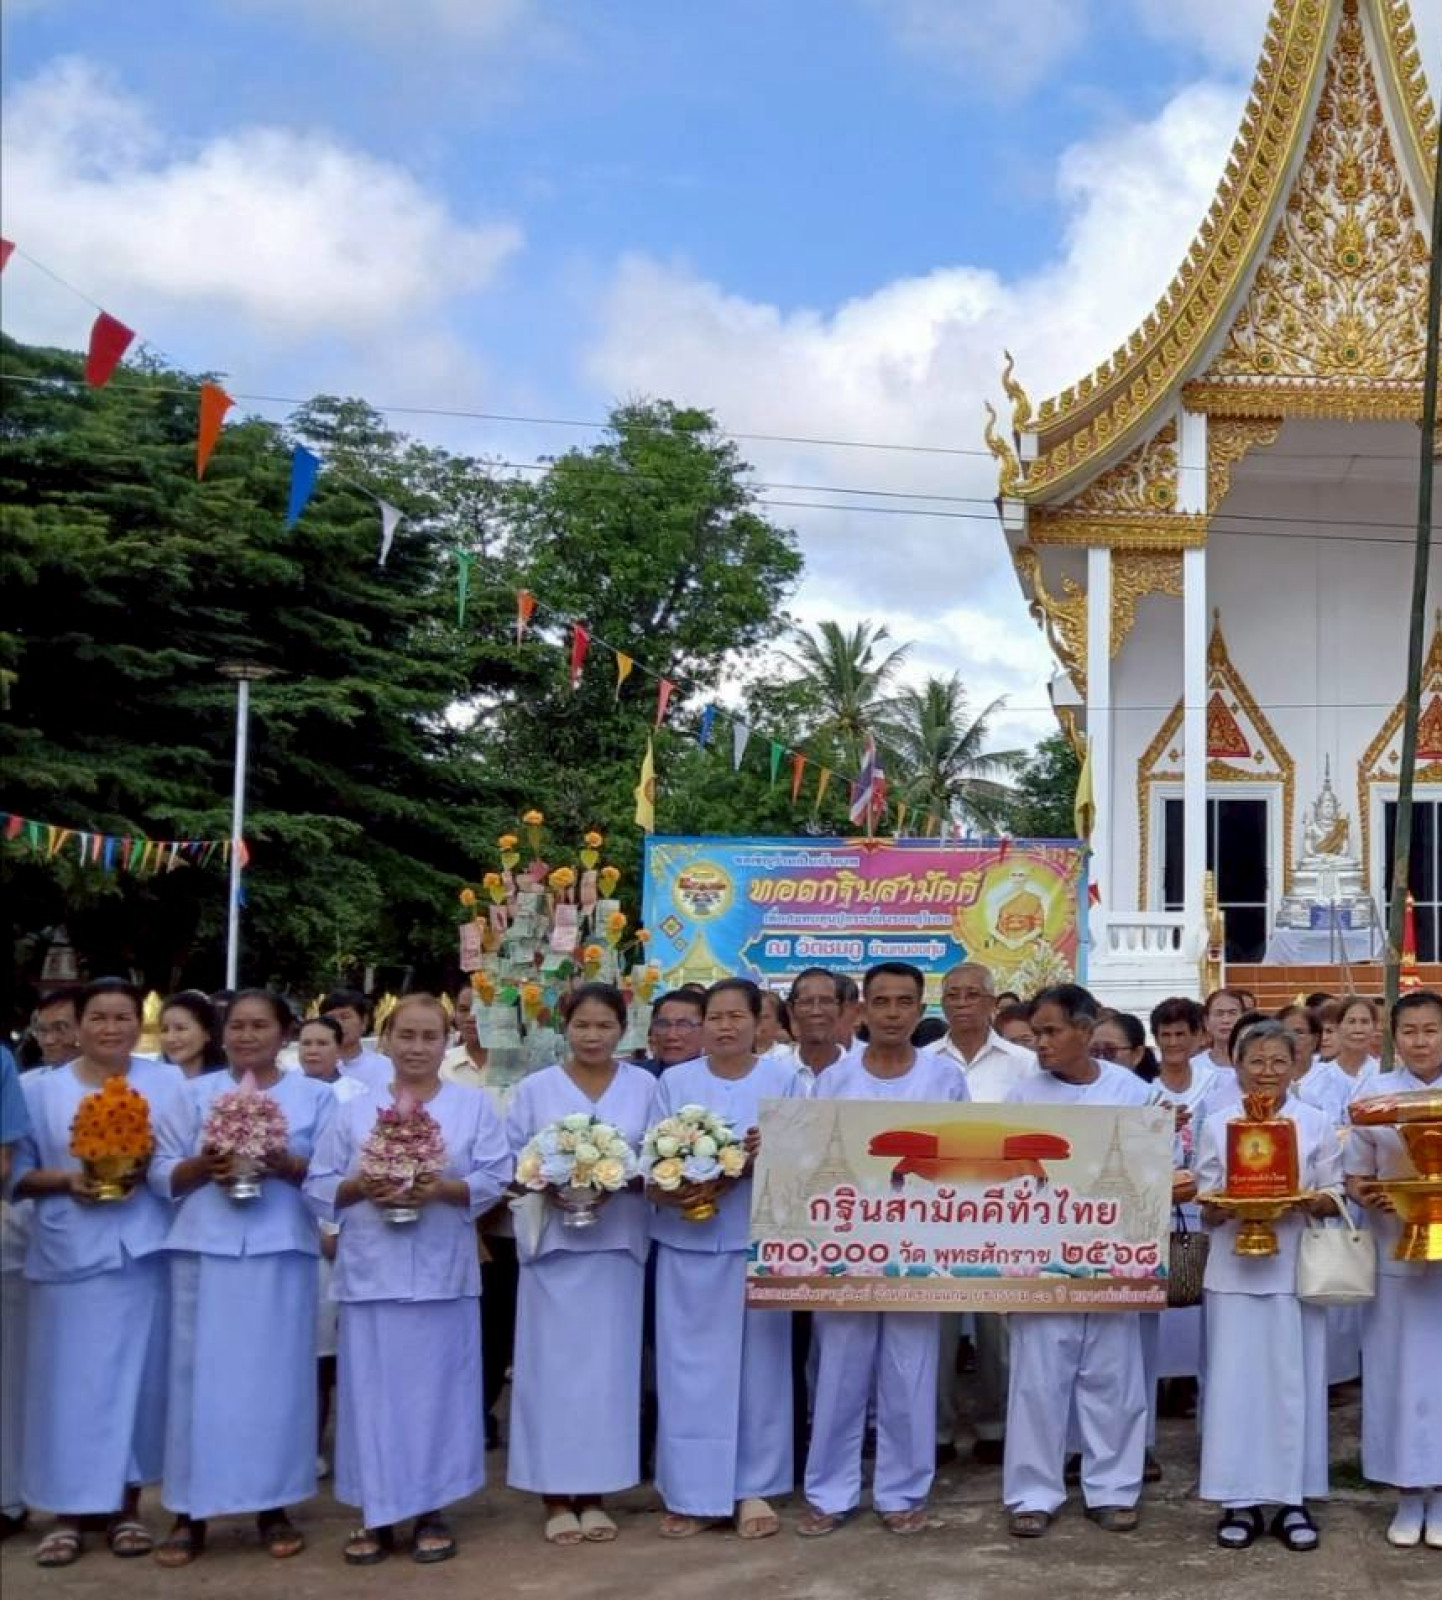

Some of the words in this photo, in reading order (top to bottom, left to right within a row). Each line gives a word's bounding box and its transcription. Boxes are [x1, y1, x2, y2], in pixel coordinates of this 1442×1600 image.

[750, 869, 982, 909] ทอดกฐินสามัคคี
[809, 1179, 1119, 1233] กฐินสามัคคีทั่วไทย
[762, 1240, 889, 1268] ๓๐,๐๐๐
[899, 1239, 927, 1264] วัด
[934, 1241, 1052, 1271] พุทธศักราช
[1060, 1239, 1160, 1266] ๒๕๖๘
